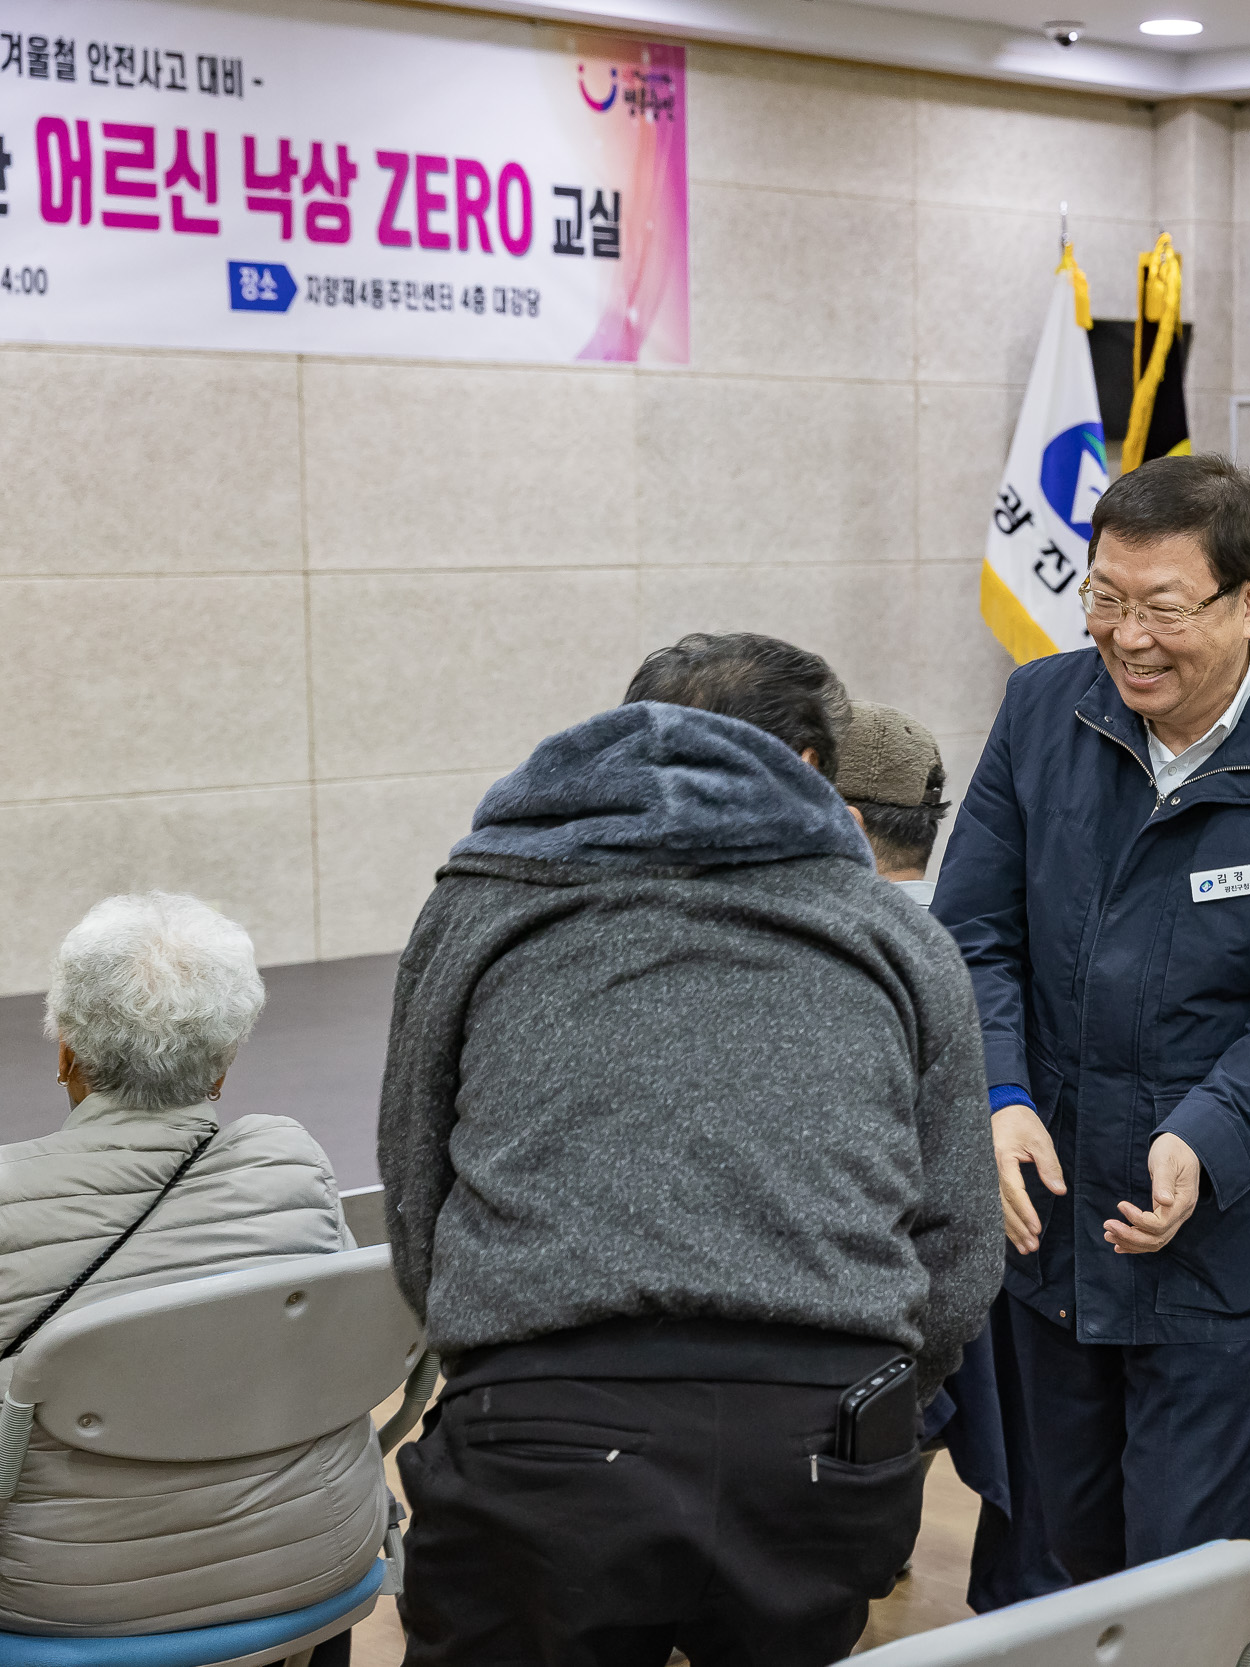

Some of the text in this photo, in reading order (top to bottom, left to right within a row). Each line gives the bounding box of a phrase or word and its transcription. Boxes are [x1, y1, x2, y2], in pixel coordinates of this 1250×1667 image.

[1, 32, 76, 81] 겨울철
[87, 42, 188, 92] 안전사고
[197, 54, 244, 99] 대비
[36, 116, 220, 236] 어르신
[243, 134, 357, 244] 낙상
[376, 150, 533, 257] ZERO
[552, 186, 620, 259] 교실
[238, 266, 279, 302] 장소
